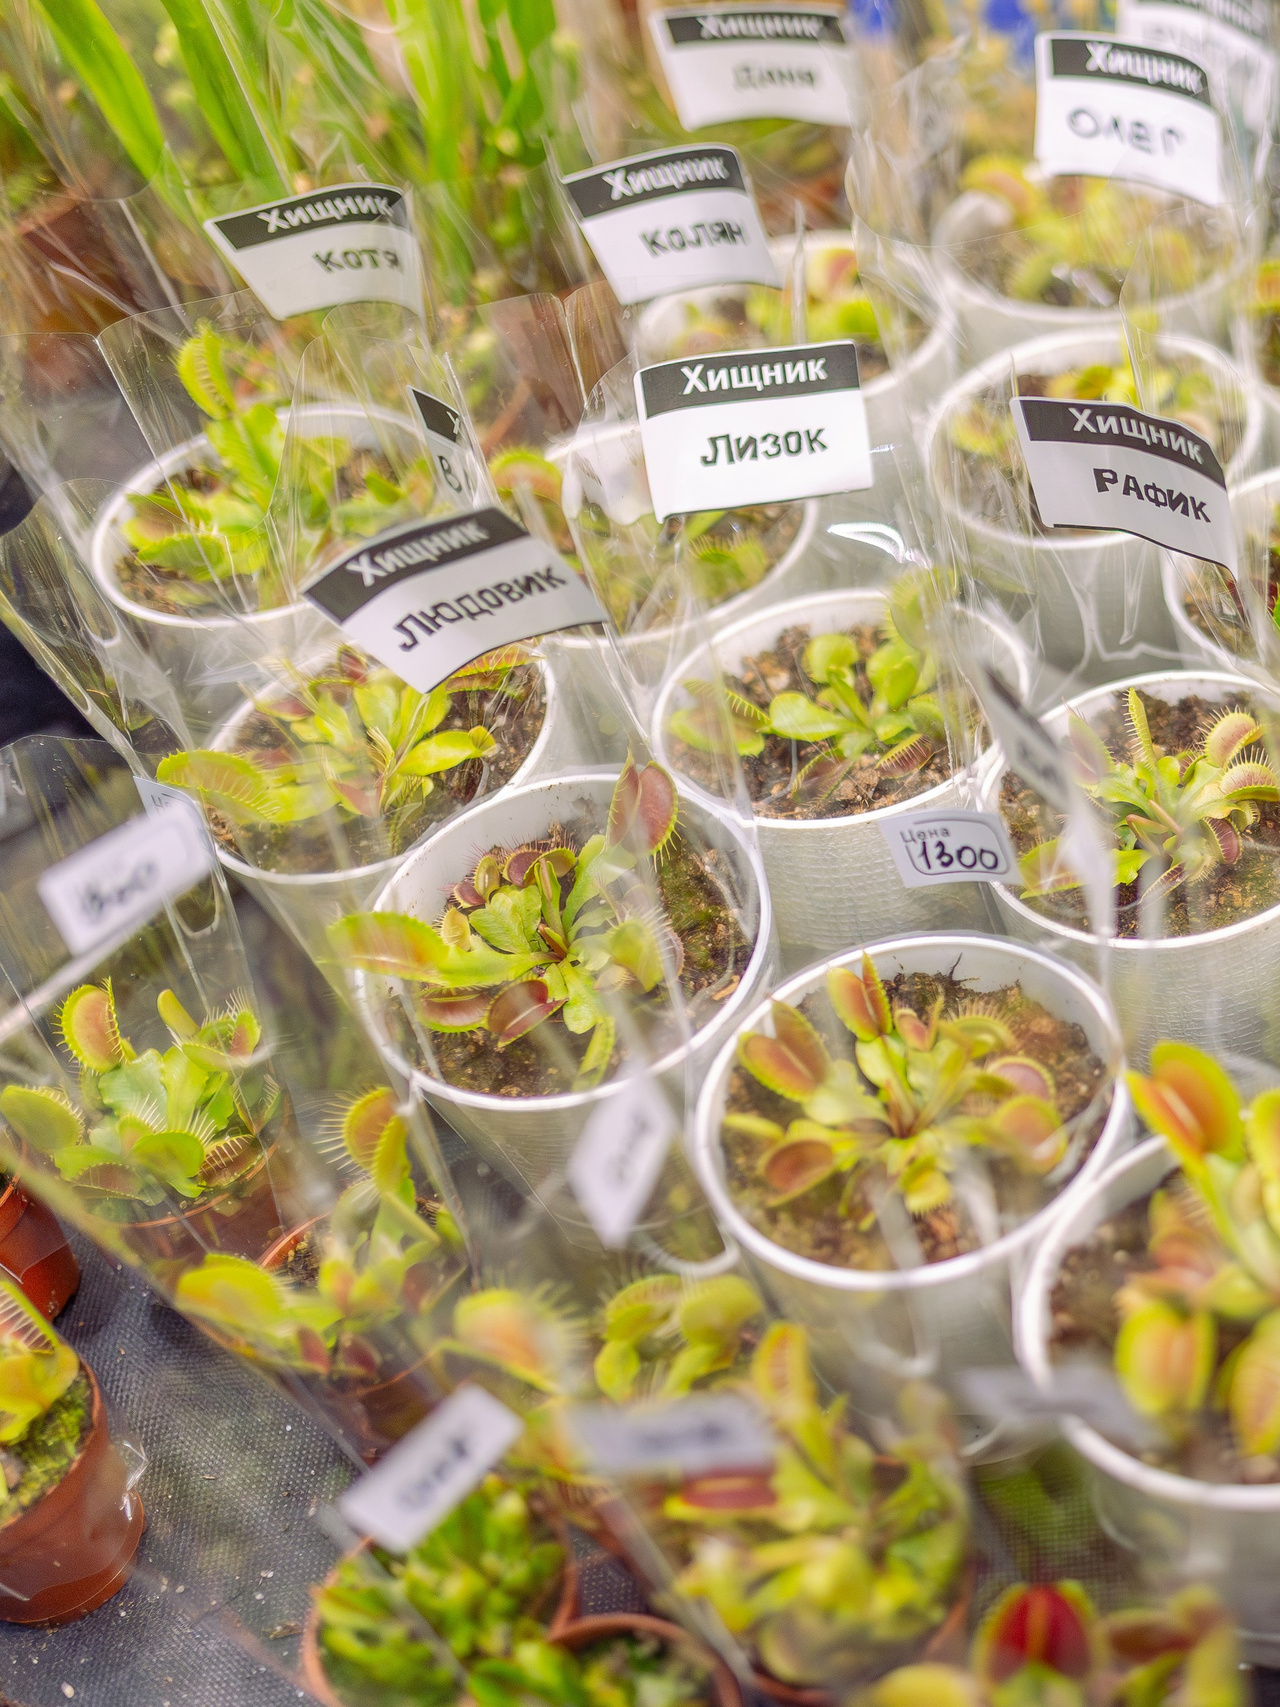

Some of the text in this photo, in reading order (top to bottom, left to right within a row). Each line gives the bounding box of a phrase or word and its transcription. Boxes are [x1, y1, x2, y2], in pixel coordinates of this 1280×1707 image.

[1086, 40, 1203, 94] Хищник
[602, 156, 730, 200] Хищник
[257, 195, 396, 233] Хищник
[680, 357, 829, 395] Хищник
[700, 427, 829, 467] Лизок
[1068, 407, 1203, 465] Хищник
[345, 519, 490, 587] Хищник
[900, 827, 950, 843] Цена
[918, 840, 998, 870] 1300
